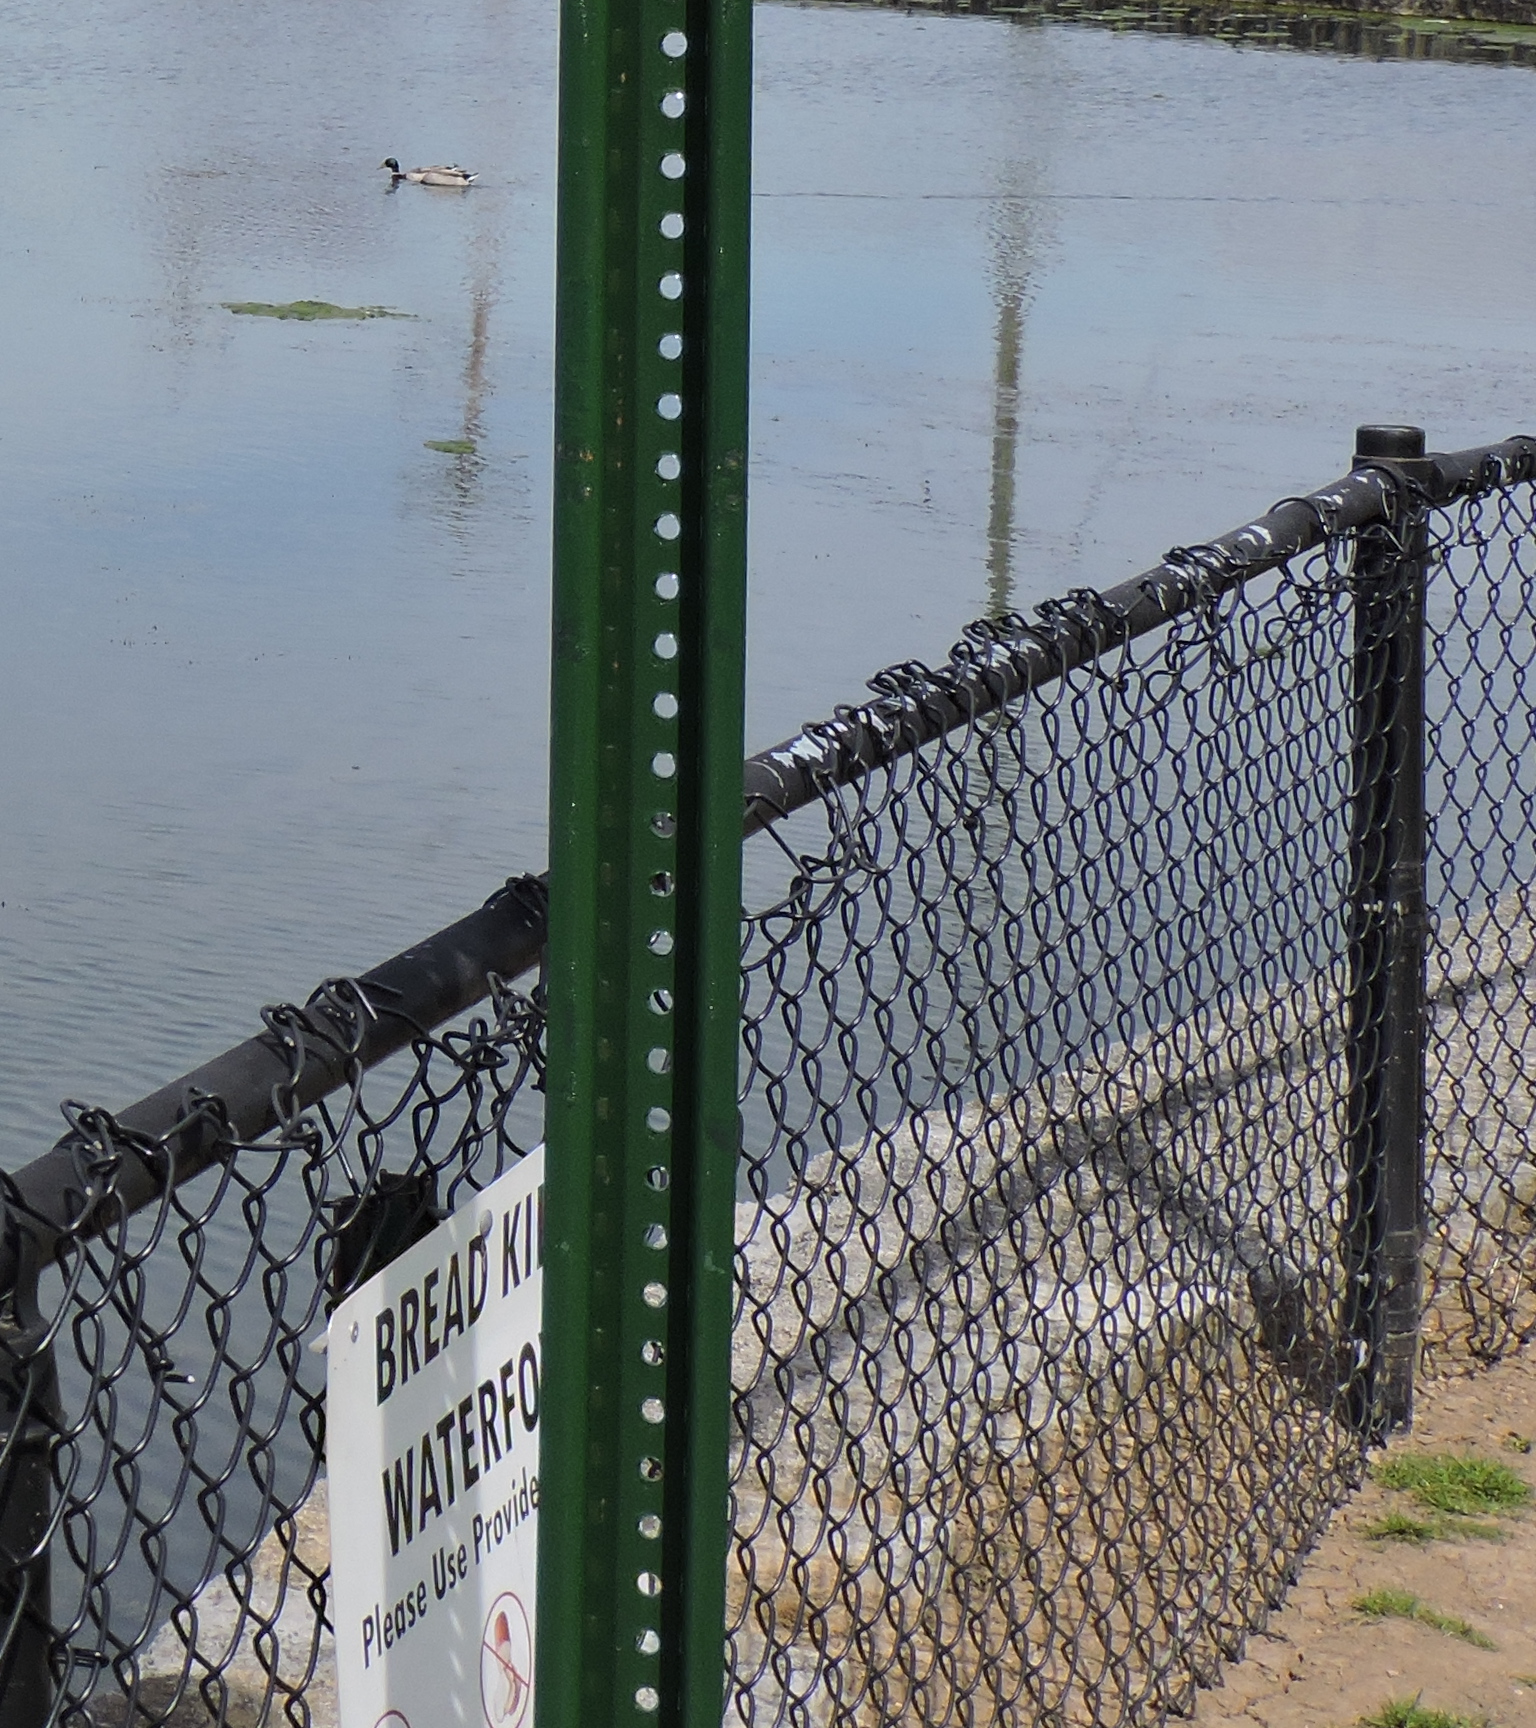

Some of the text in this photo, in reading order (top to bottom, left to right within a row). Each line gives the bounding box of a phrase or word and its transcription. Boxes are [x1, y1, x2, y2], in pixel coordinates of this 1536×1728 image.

[375, 1234, 488, 1407] BREAD
[382, 1332, 543, 1557] WATERFO
[362, 1579, 427, 1670] Please
[432, 1542, 468, 1601] Use
